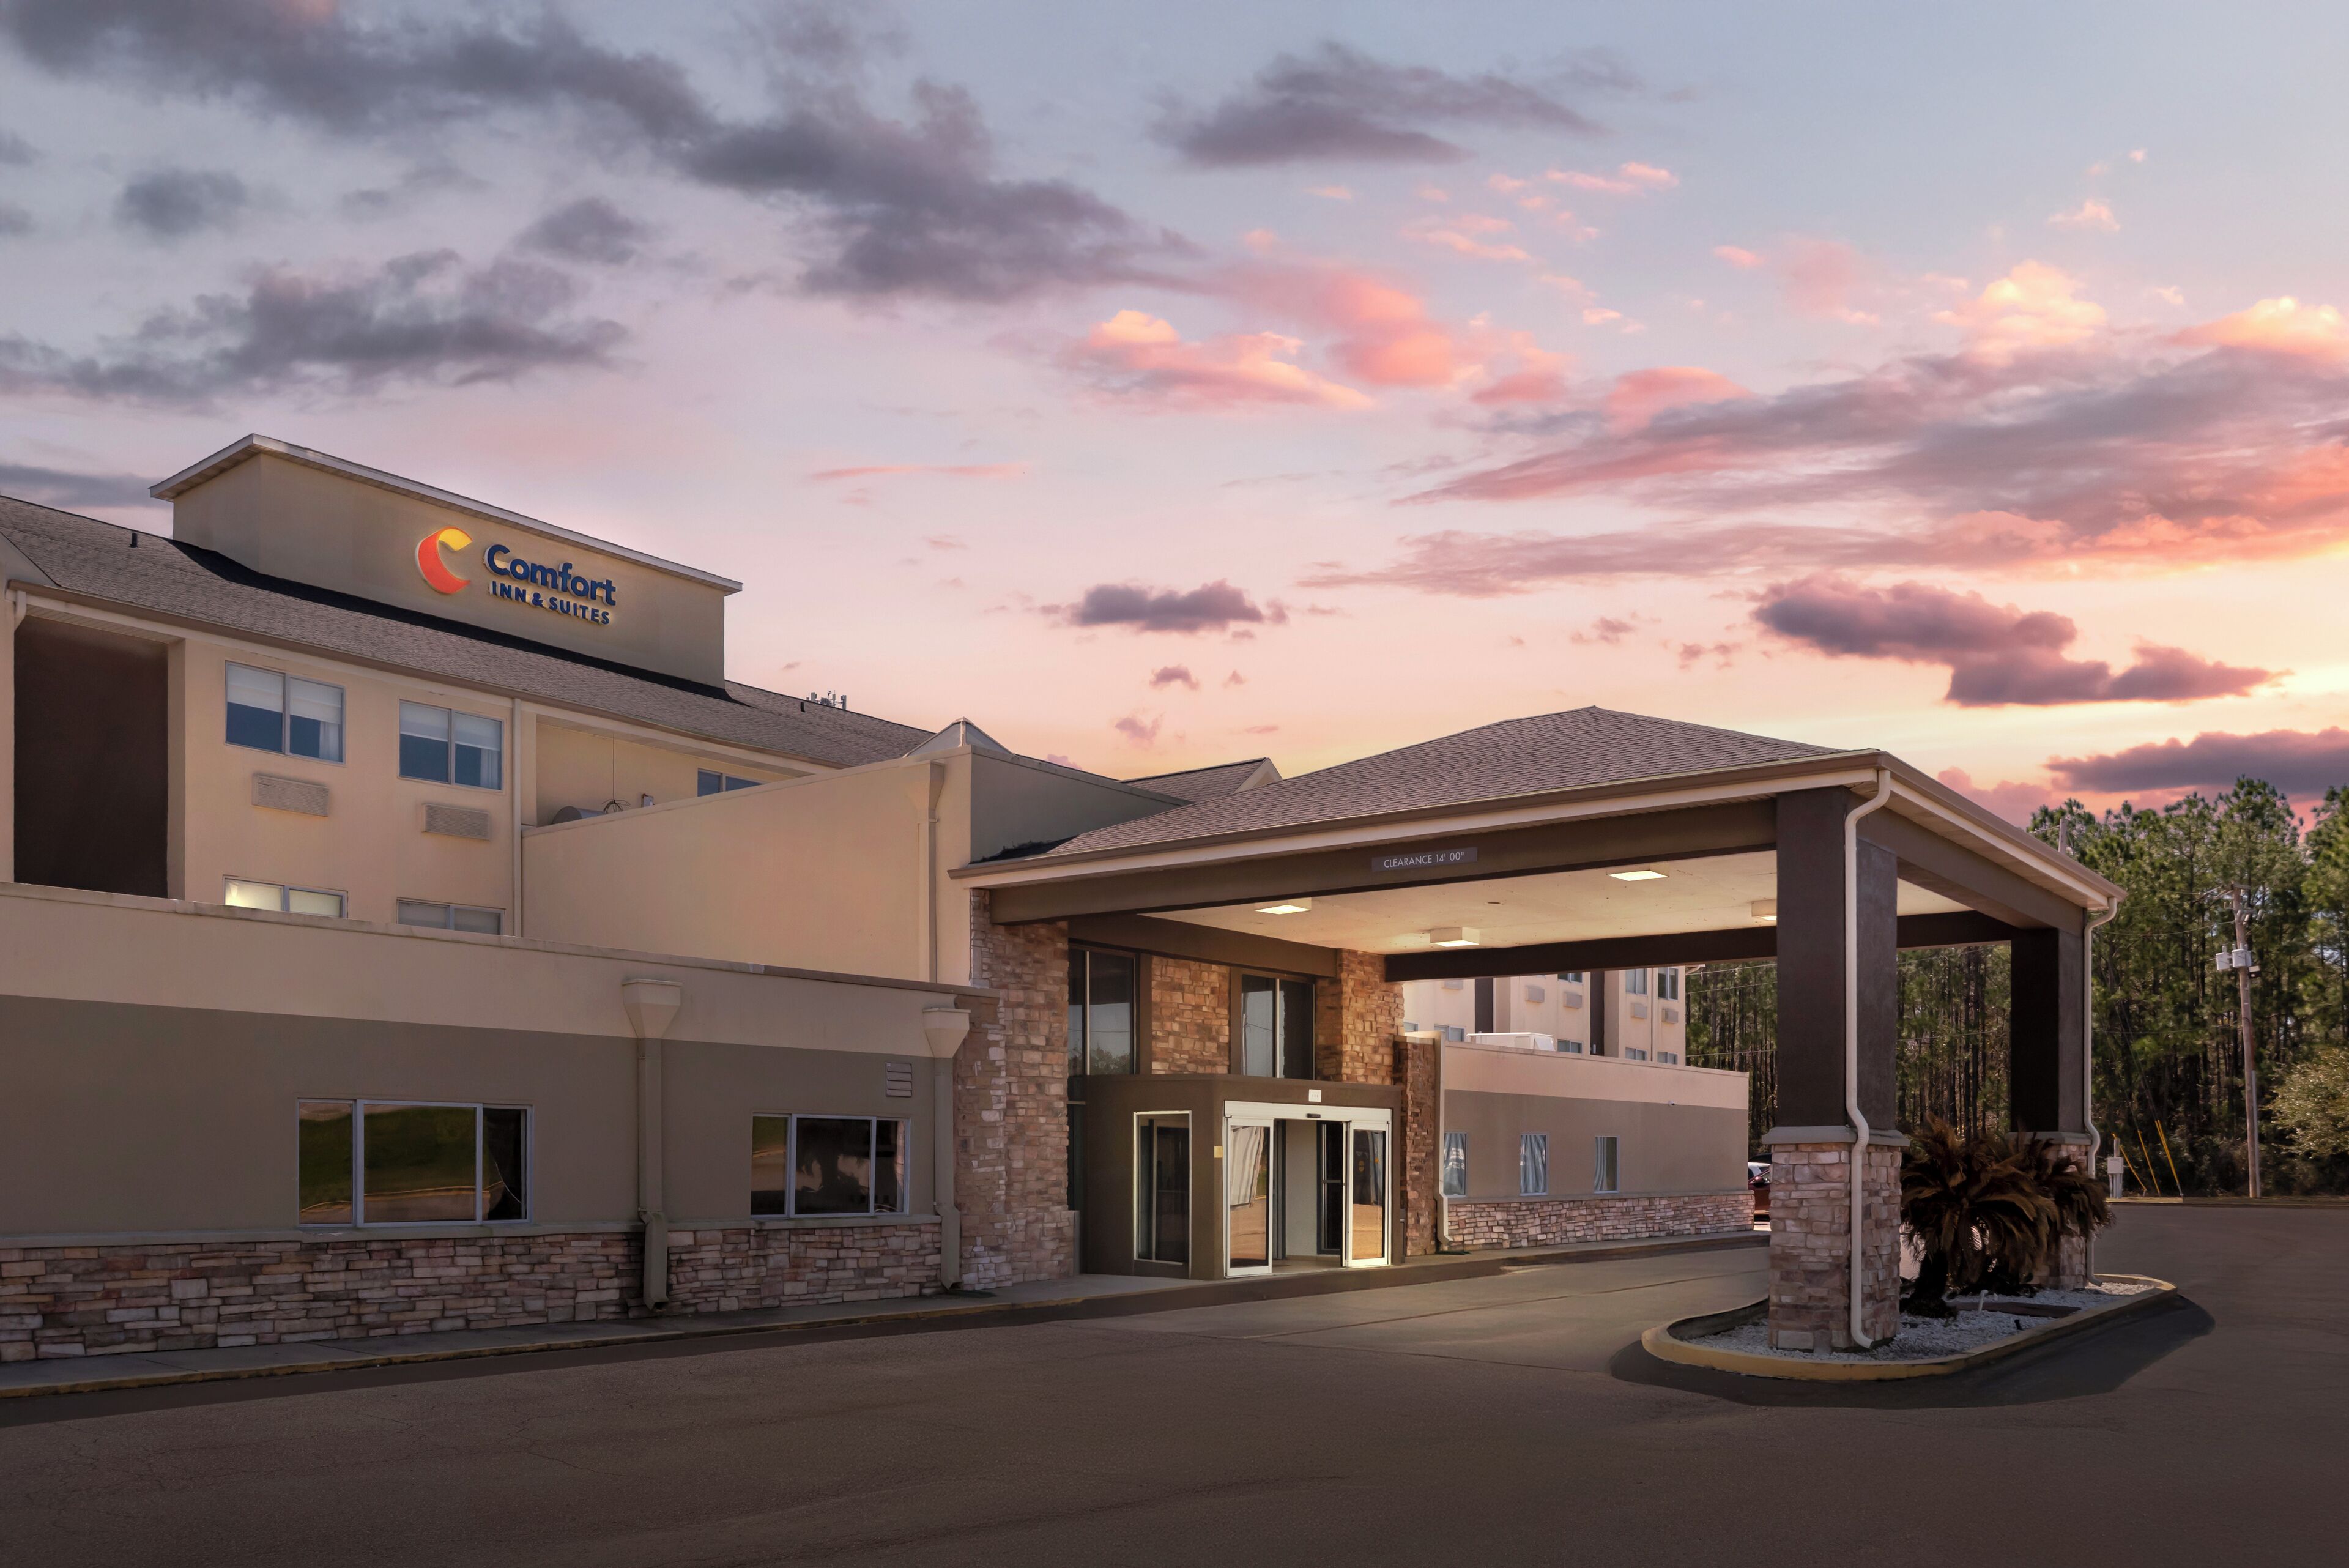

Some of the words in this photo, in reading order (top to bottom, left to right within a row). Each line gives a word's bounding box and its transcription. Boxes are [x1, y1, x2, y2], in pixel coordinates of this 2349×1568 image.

[484, 544, 616, 606] Comfort
[489, 581, 527, 603] INN
[532, 592, 544, 608] &
[549, 596, 610, 626] SUITES
[1384, 855, 1432, 868] CLEARANCE
[1436, 854, 1446, 863] 14'
